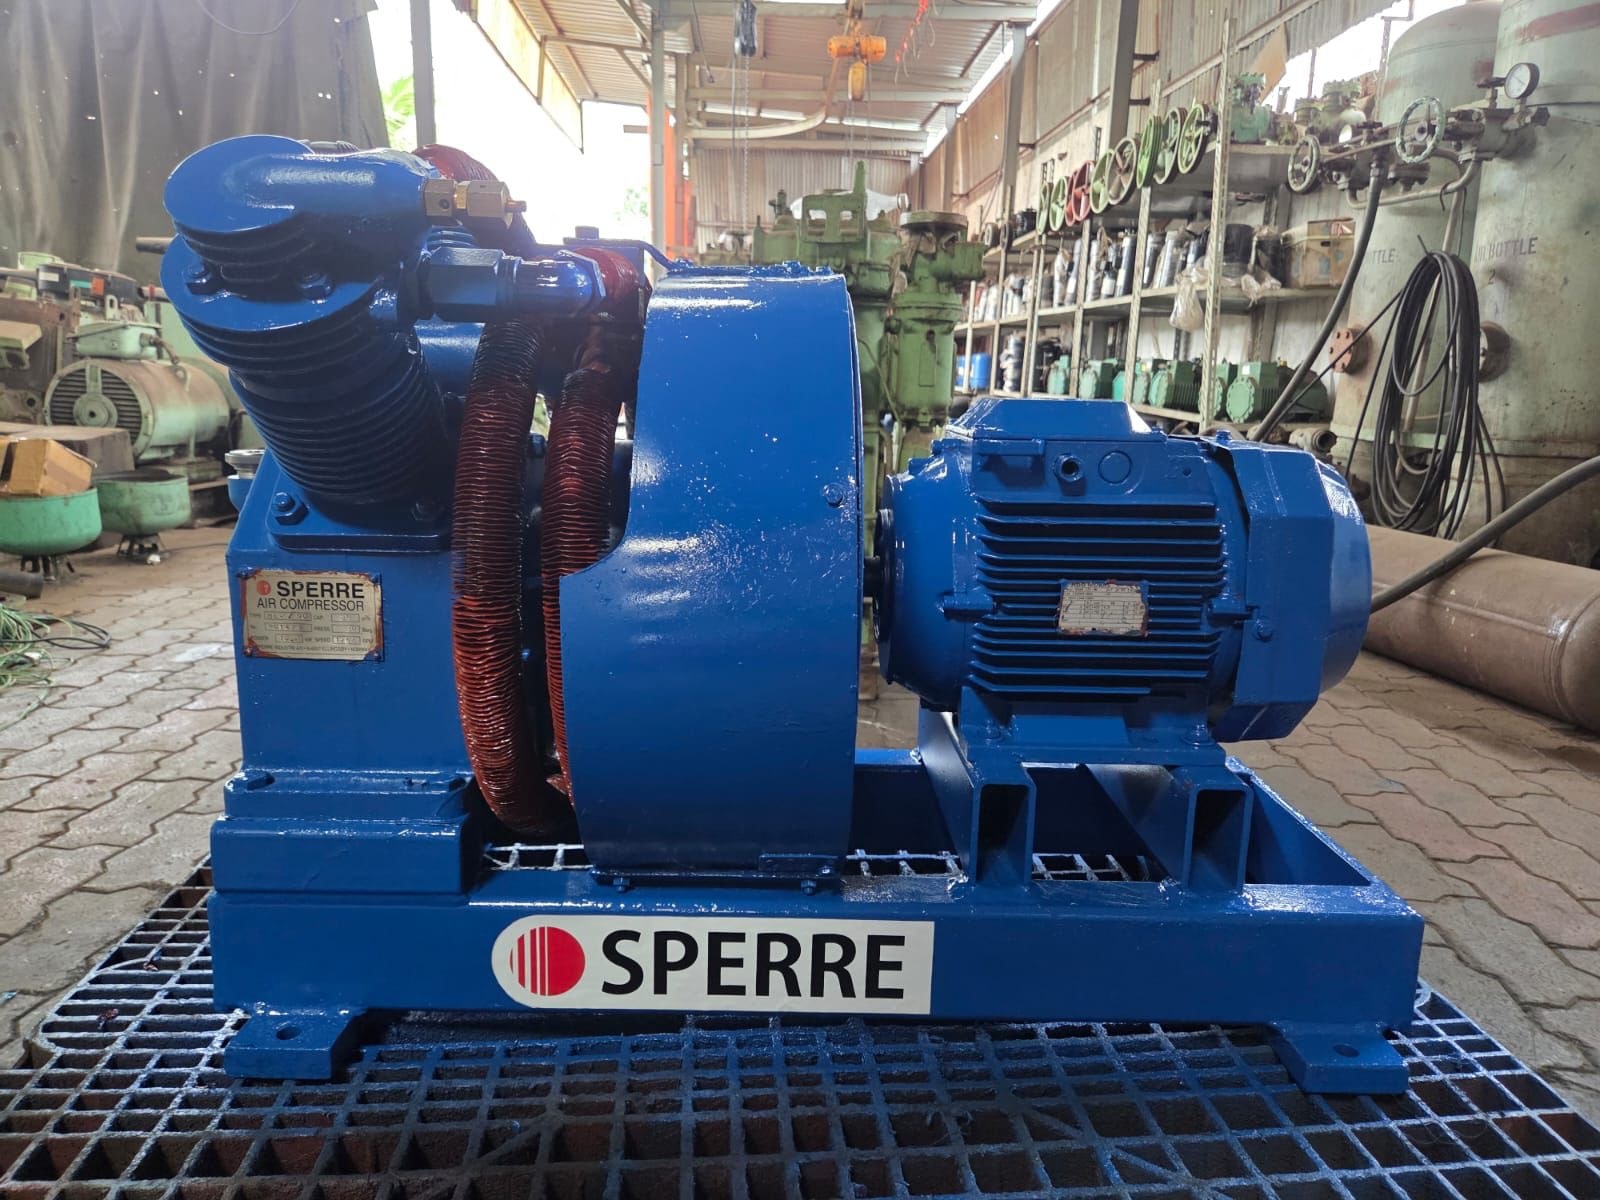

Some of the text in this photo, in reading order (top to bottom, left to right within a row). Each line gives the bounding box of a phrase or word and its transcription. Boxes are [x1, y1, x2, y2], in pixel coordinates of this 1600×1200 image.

[1489, 236, 1539, 259] BOTTLE
[277, 581, 365, 599] SPERRE
[257, 598, 364, 611] AIR COMPRESSOR
[601, 929, 906, 999] SPERRE
